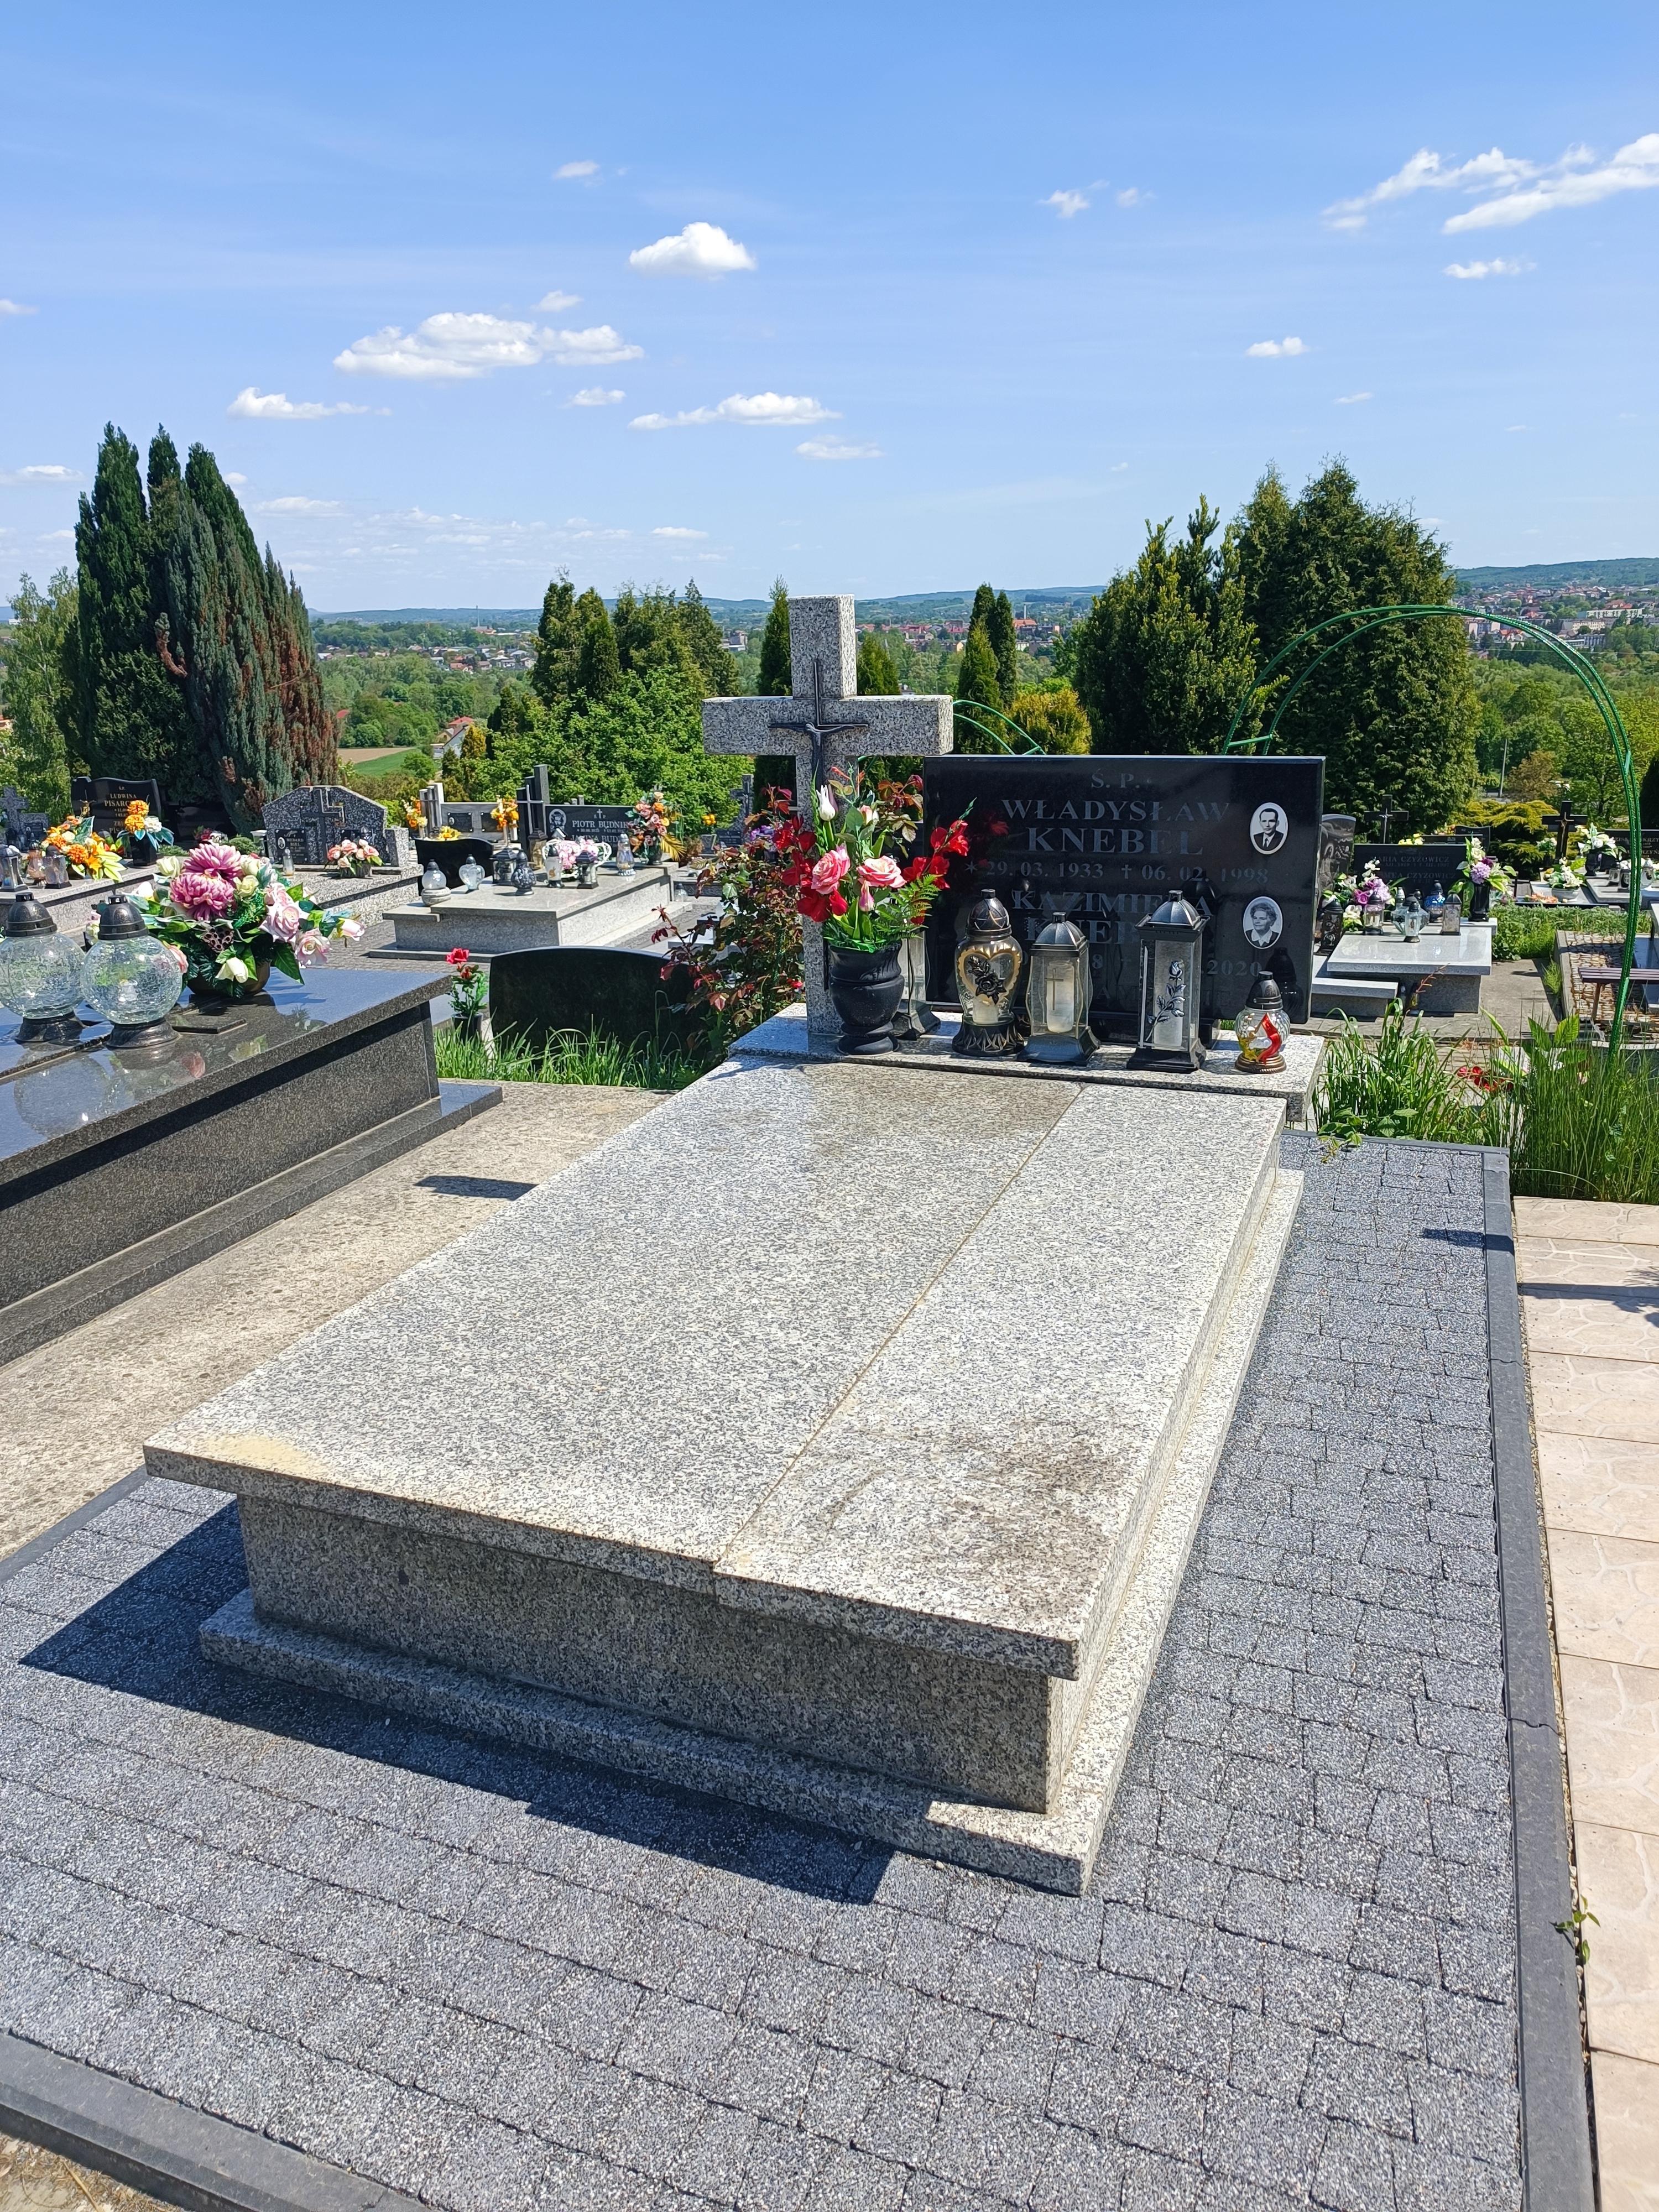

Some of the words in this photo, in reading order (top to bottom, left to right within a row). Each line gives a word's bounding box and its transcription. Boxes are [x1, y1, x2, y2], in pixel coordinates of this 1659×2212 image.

[1119, 773, 1140, 789] P.
[1001, 799, 1230, 822] WŁADYSŁAW
[1025, 827, 1204, 855] KNEBEL
[1020, 861, 1049, 877] 03.
[1058, 862, 1104, 878] 1933
[1141, 864, 1172, 881] 06.
[1179, 866, 1209, 882] 02.
[1221, 868, 1269, 884] 1998
[1011, 890, 1214, 916] KAZIMIEA
